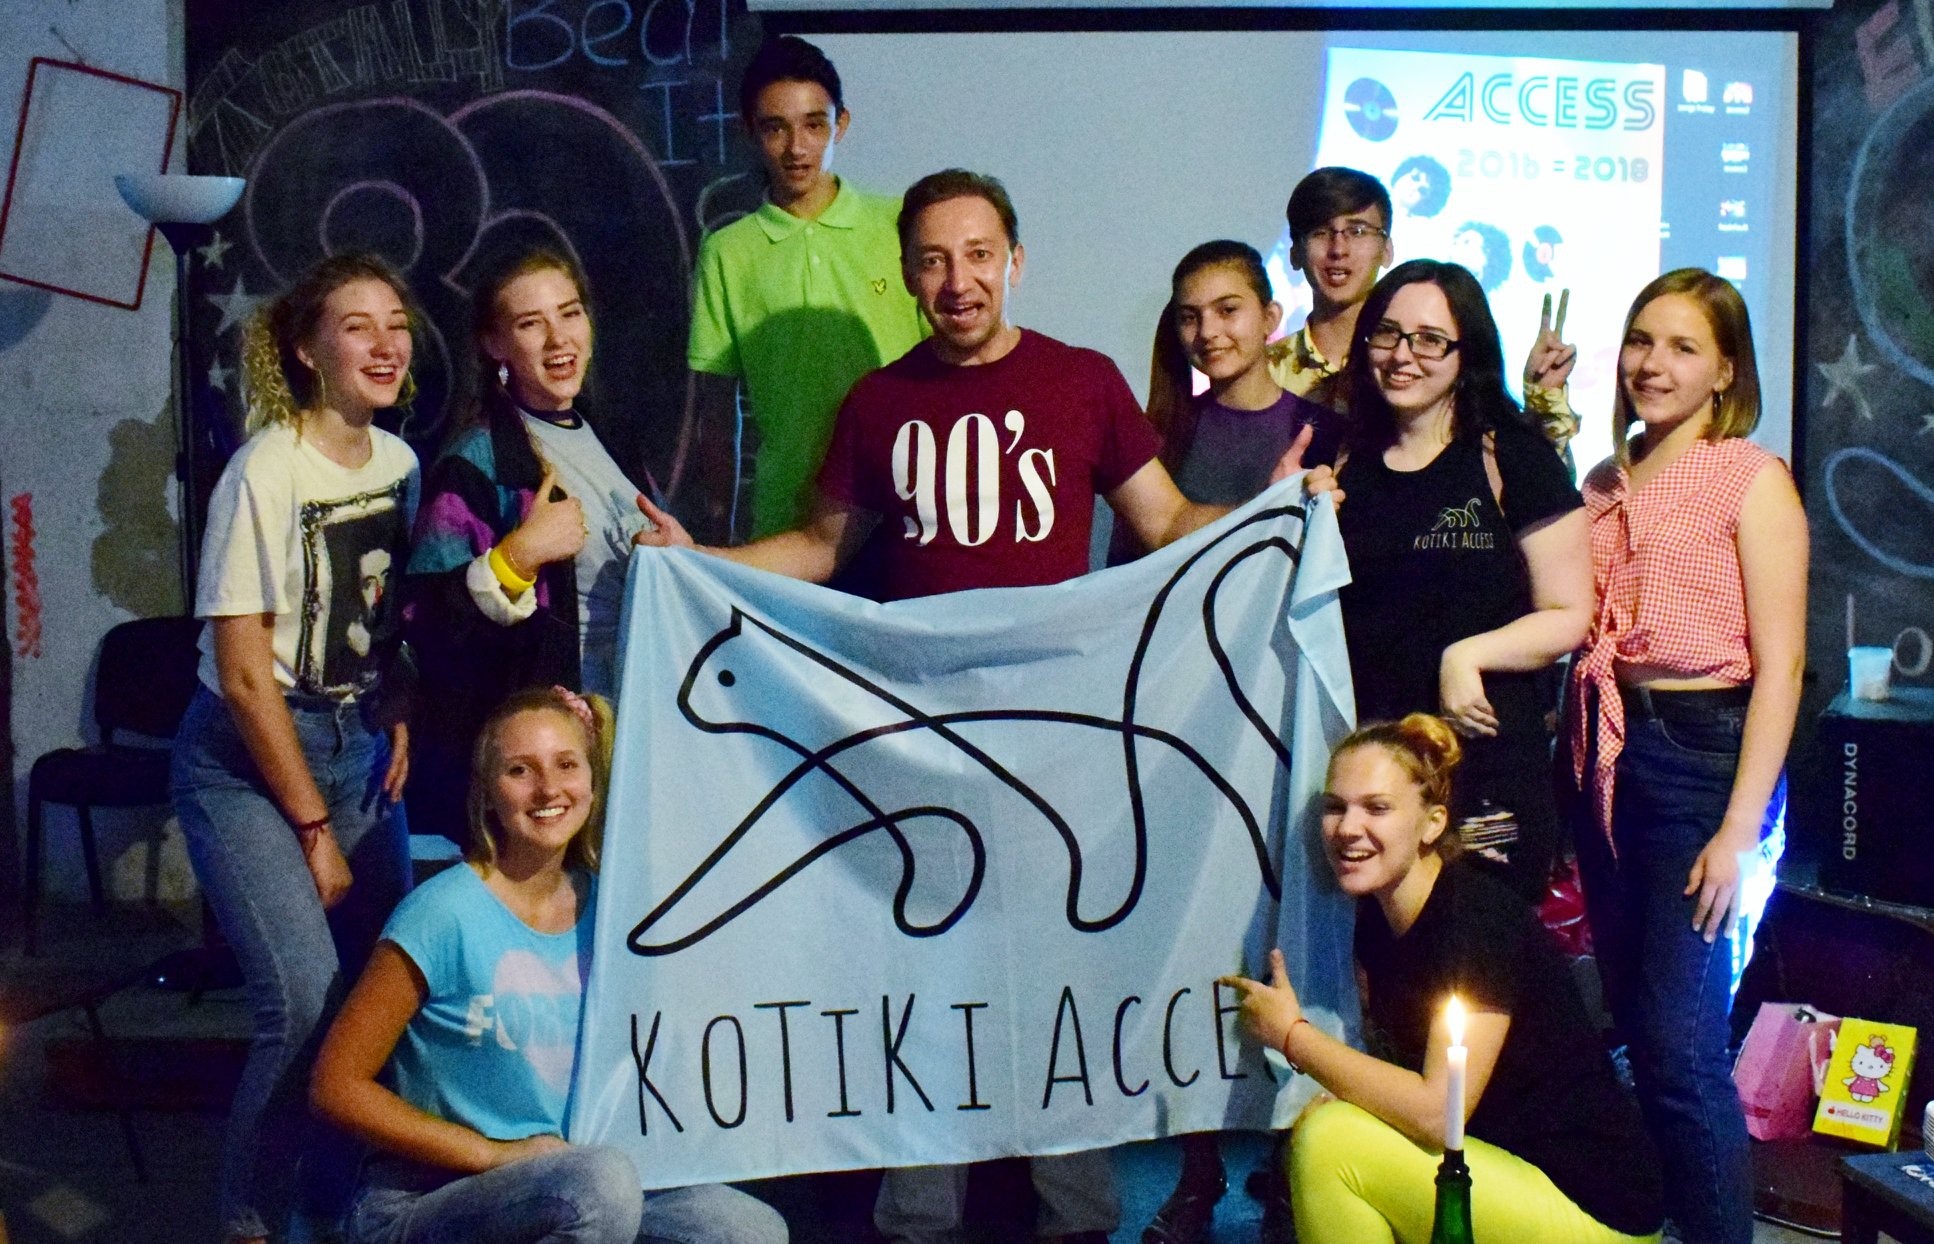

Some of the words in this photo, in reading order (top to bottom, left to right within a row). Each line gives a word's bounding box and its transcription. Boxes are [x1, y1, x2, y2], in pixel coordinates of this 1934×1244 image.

[1422, 71, 1656, 131] ACCESS
[1573, 154, 1650, 183] 2018
[1413, 531, 1457, 550] KOTIKI
[1461, 531, 1495, 549] ACCESS
[1842, 742, 1858, 861] DYNACORD
[630, 993, 992, 1137] KOTIKI
[1041, 979, 1278, 1110] ACCE
[1837, 1109, 1860, 1119] HELLO
[1862, 1114, 1883, 1123] KITTY
